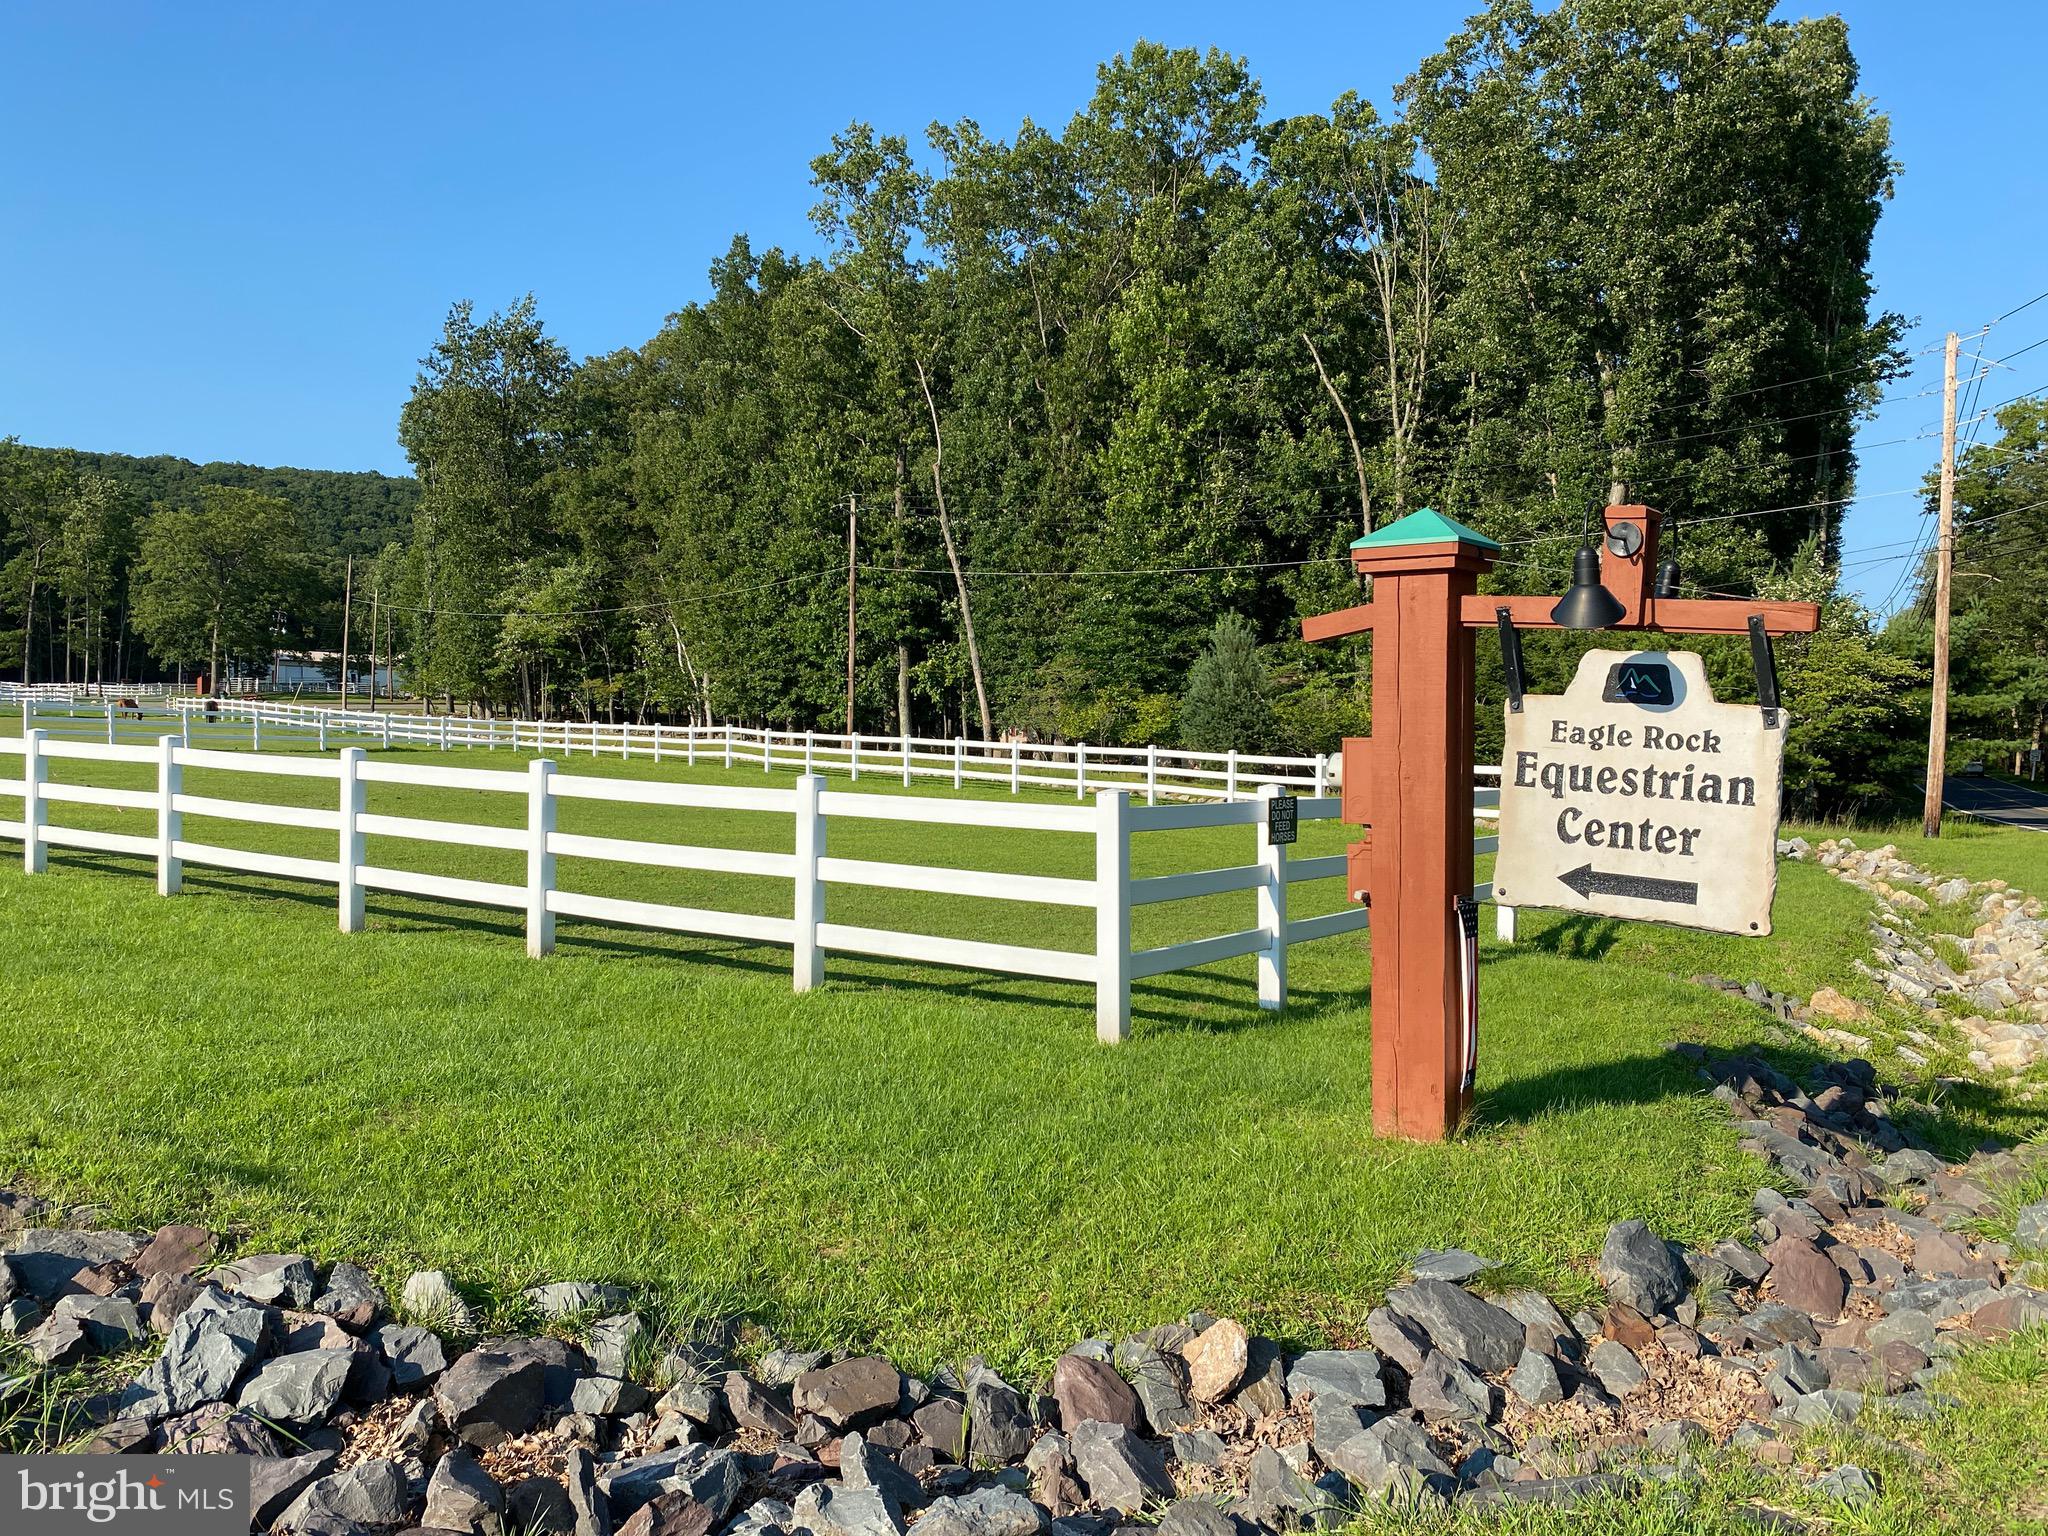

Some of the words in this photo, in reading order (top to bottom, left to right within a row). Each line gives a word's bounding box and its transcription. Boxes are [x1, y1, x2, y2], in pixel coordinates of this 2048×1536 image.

[1550, 720, 1633, 750] Eagle
[1643, 725, 1721, 753] Rock
[1514, 751, 1756, 807] Equestrian
[1271, 799, 1294, 809] PLEASE
[1271, 811, 1281, 820] DO
[1281, 810, 1294, 819] NOT
[1275, 821, 1290, 831] FEED
[1556, 807, 1701, 856] Center
[1271, 831, 1295, 842] HORSES
